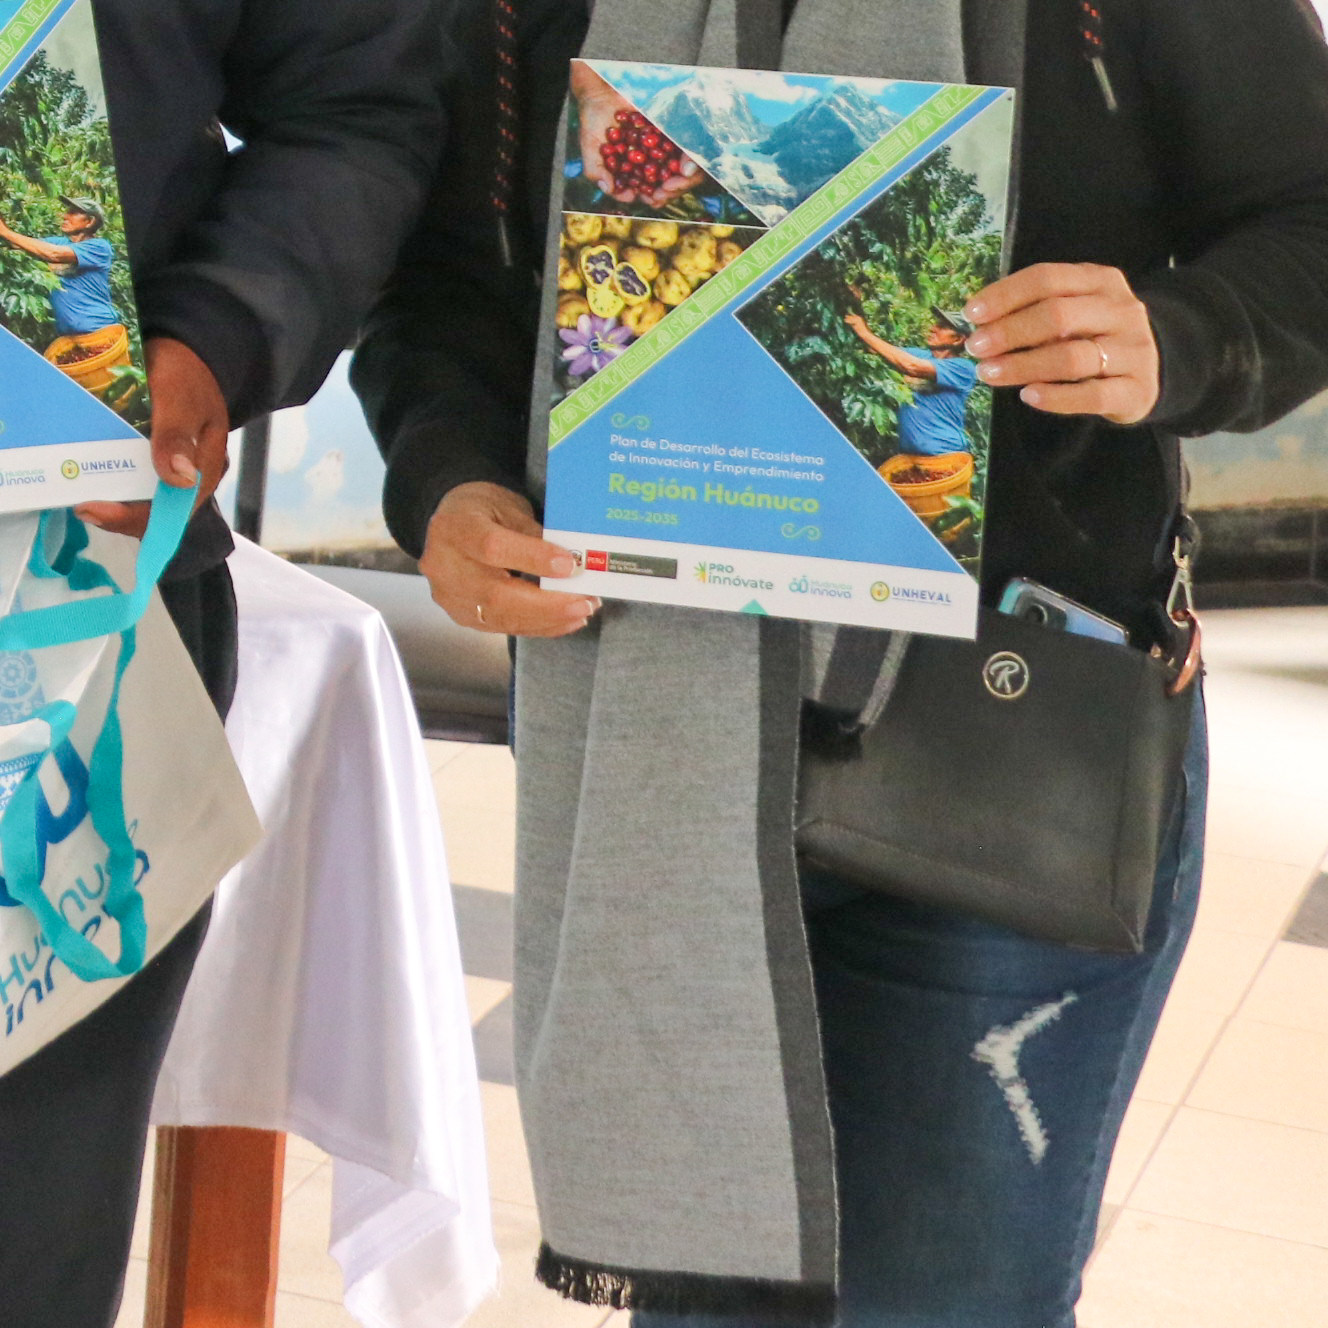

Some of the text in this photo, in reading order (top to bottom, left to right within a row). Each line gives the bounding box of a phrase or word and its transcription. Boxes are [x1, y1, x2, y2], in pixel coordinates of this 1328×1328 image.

[610, 434, 824, 465] Plan de Desarrollo del Ecosistema
[81, 459, 136, 471] UNHEVAL
[609, 451, 824, 482] de Innovación y Emprendimiento
[7, 475, 45, 485] innova
[608, 473, 819, 513] Región Huánuco
[606, 508, 678, 524] 2025-2035
[709, 563, 734, 573] PRO
[709, 574, 773, 589] innóvate
[810, 588, 851, 598] innova
[892, 587, 951, 602] UNHEVAL
